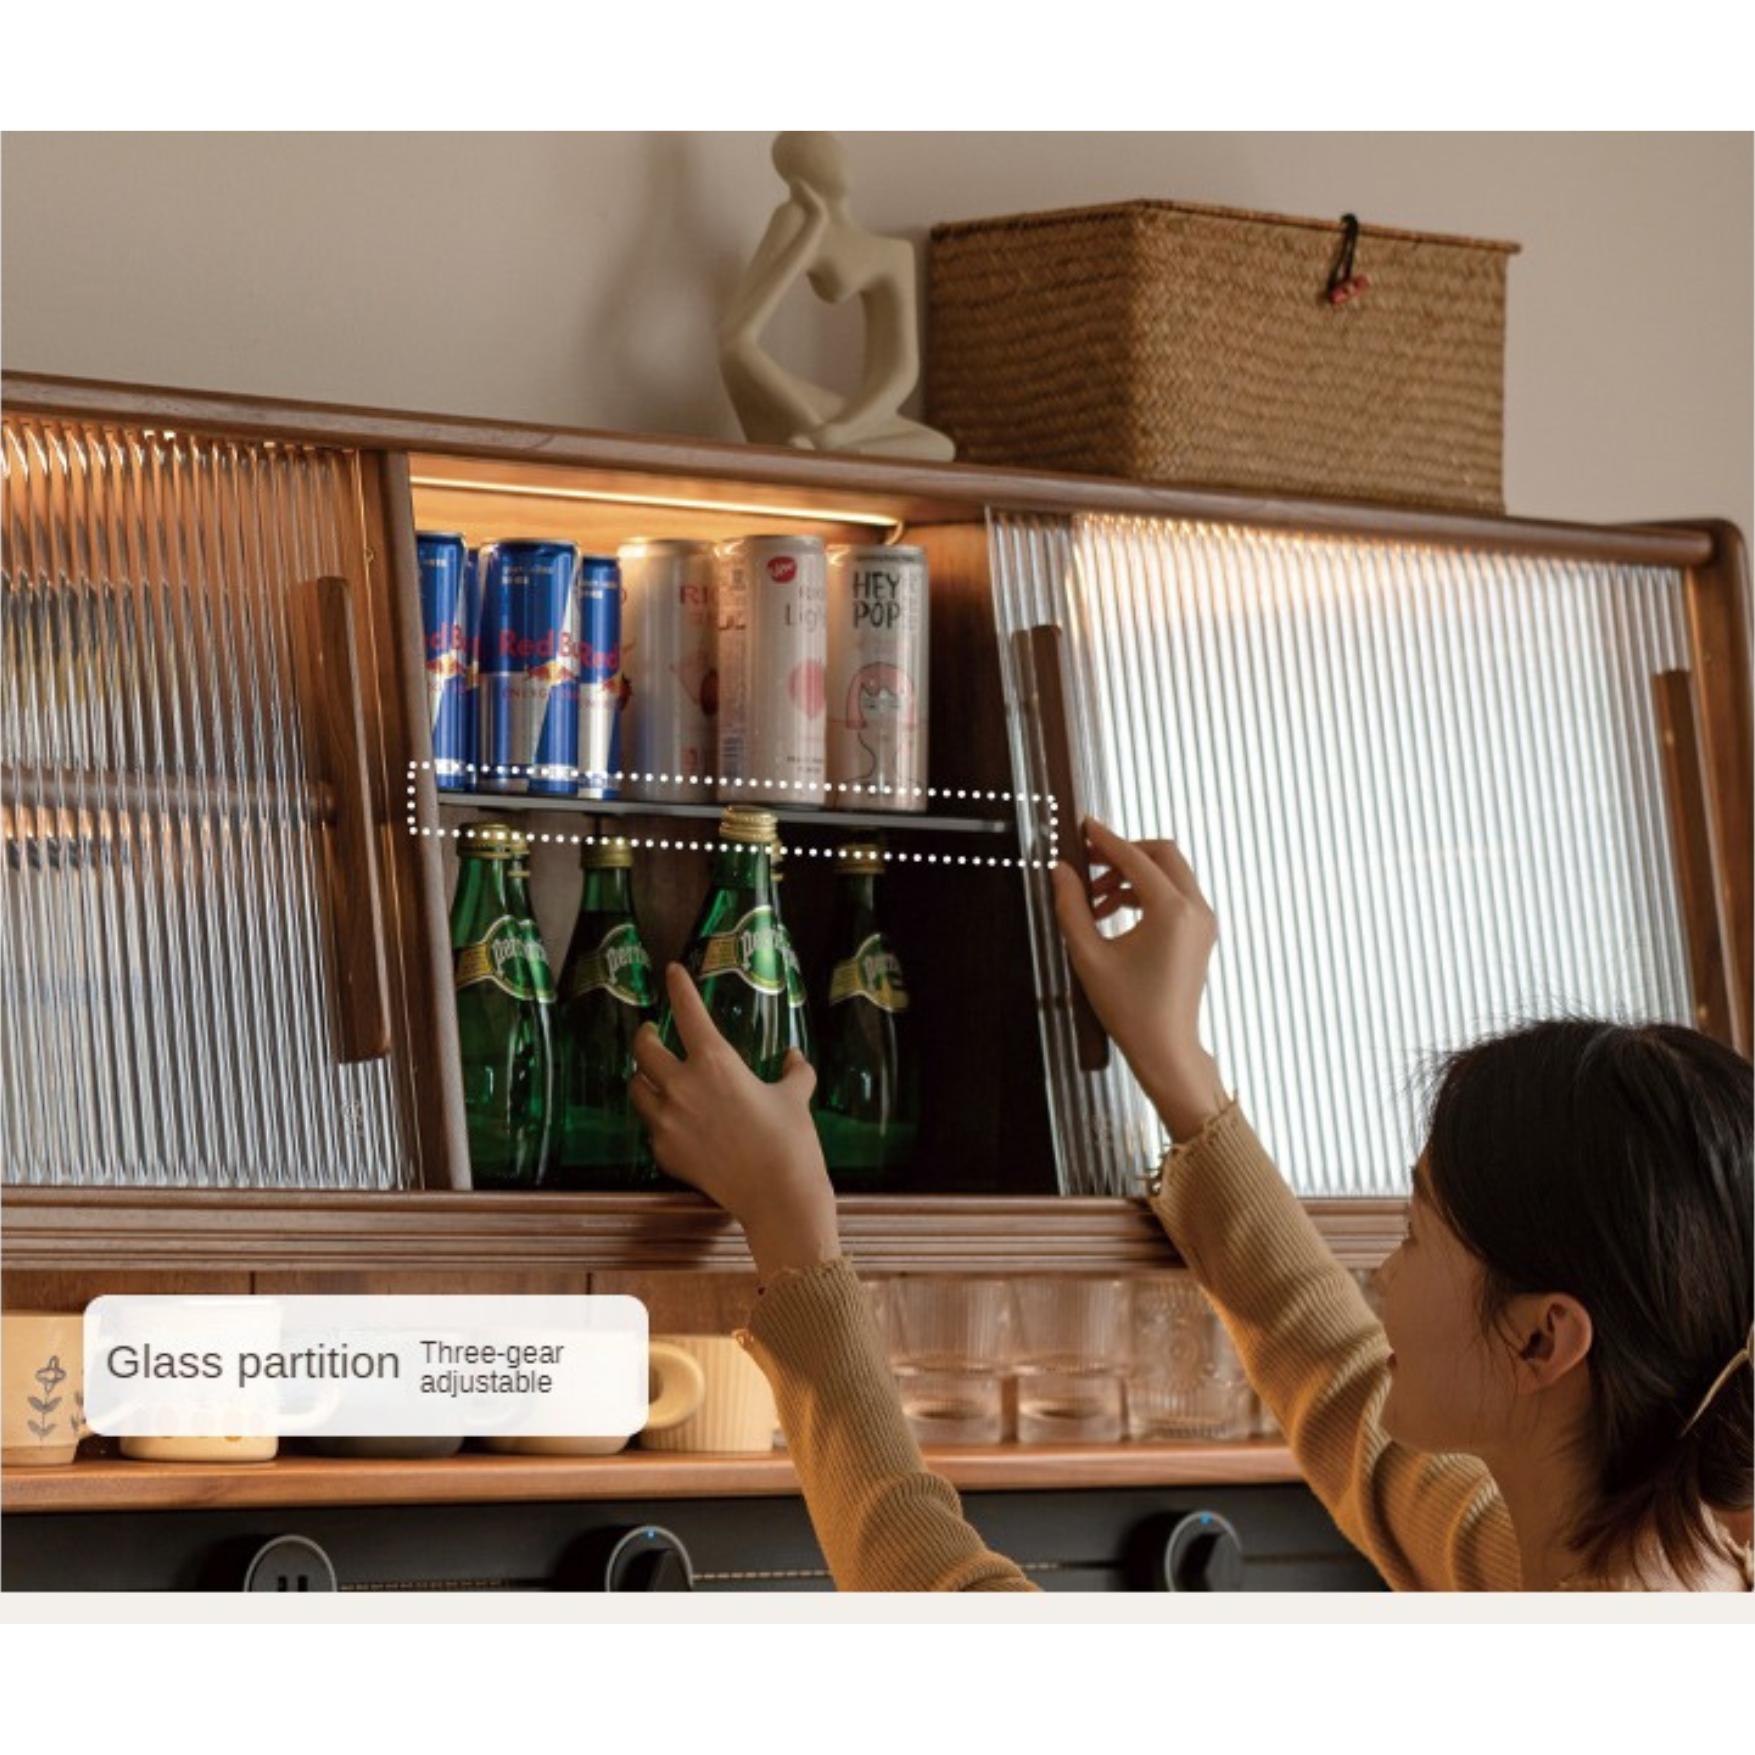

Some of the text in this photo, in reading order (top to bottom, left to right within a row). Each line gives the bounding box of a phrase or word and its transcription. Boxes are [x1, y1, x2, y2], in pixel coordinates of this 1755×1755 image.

[852, 570, 900, 600] HEY
[852, 600, 900, 630] POP
[500, 628, 554, 658] Red
